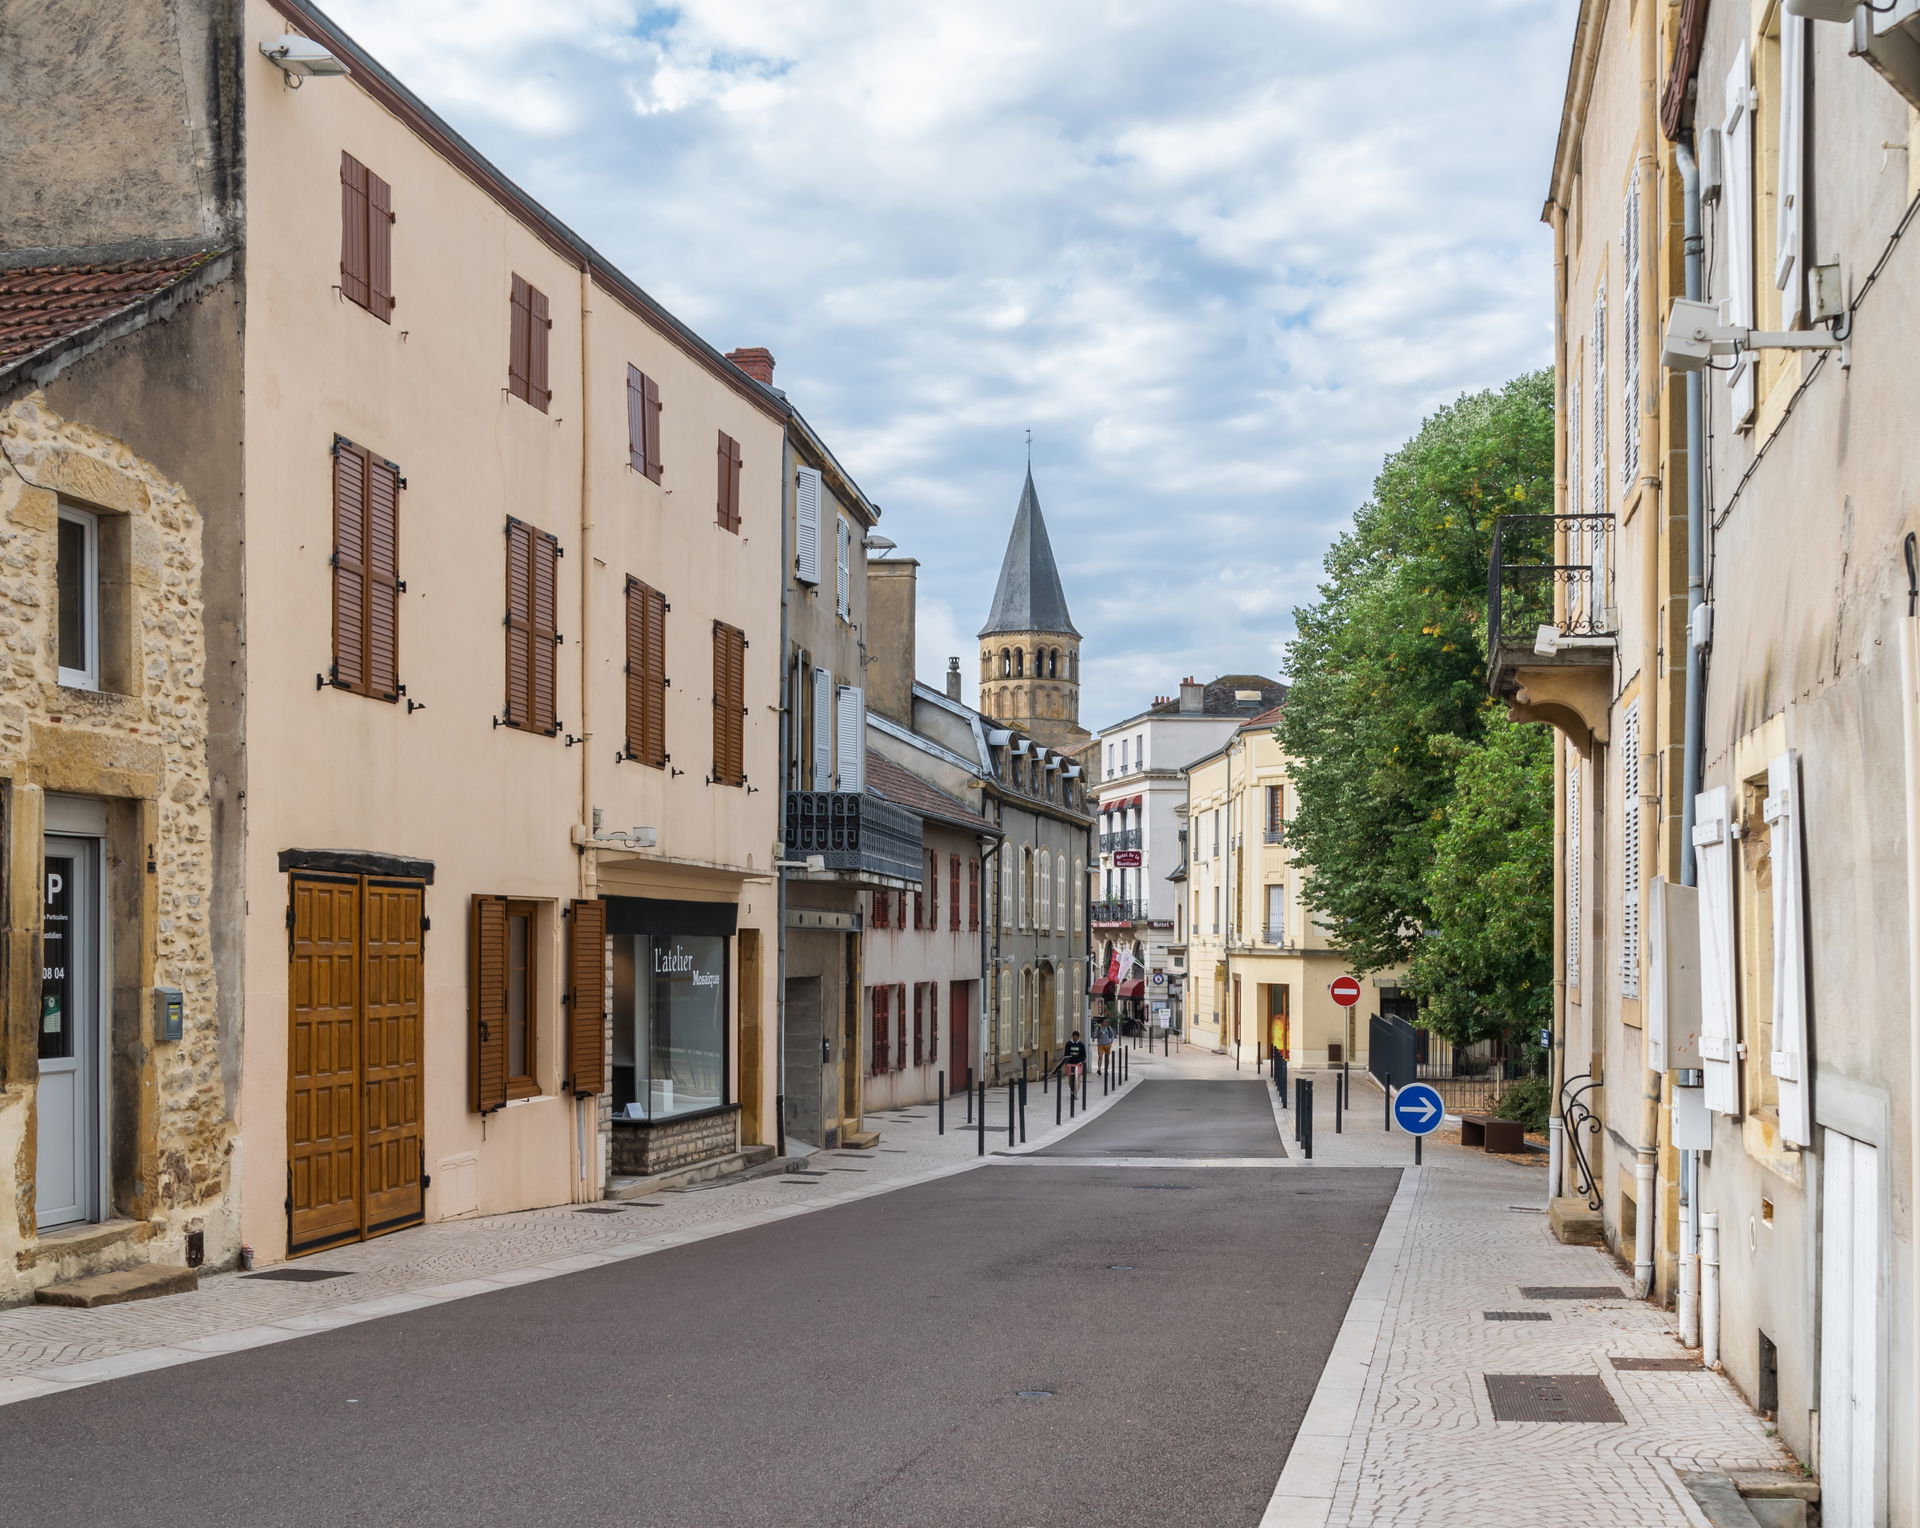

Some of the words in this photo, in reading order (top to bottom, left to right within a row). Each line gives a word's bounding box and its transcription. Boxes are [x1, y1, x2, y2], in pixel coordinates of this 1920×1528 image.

[748, 903, 752, 914] 3
[655, 945, 693, 972] L'atelier
[54, 967, 65, 979] 04
